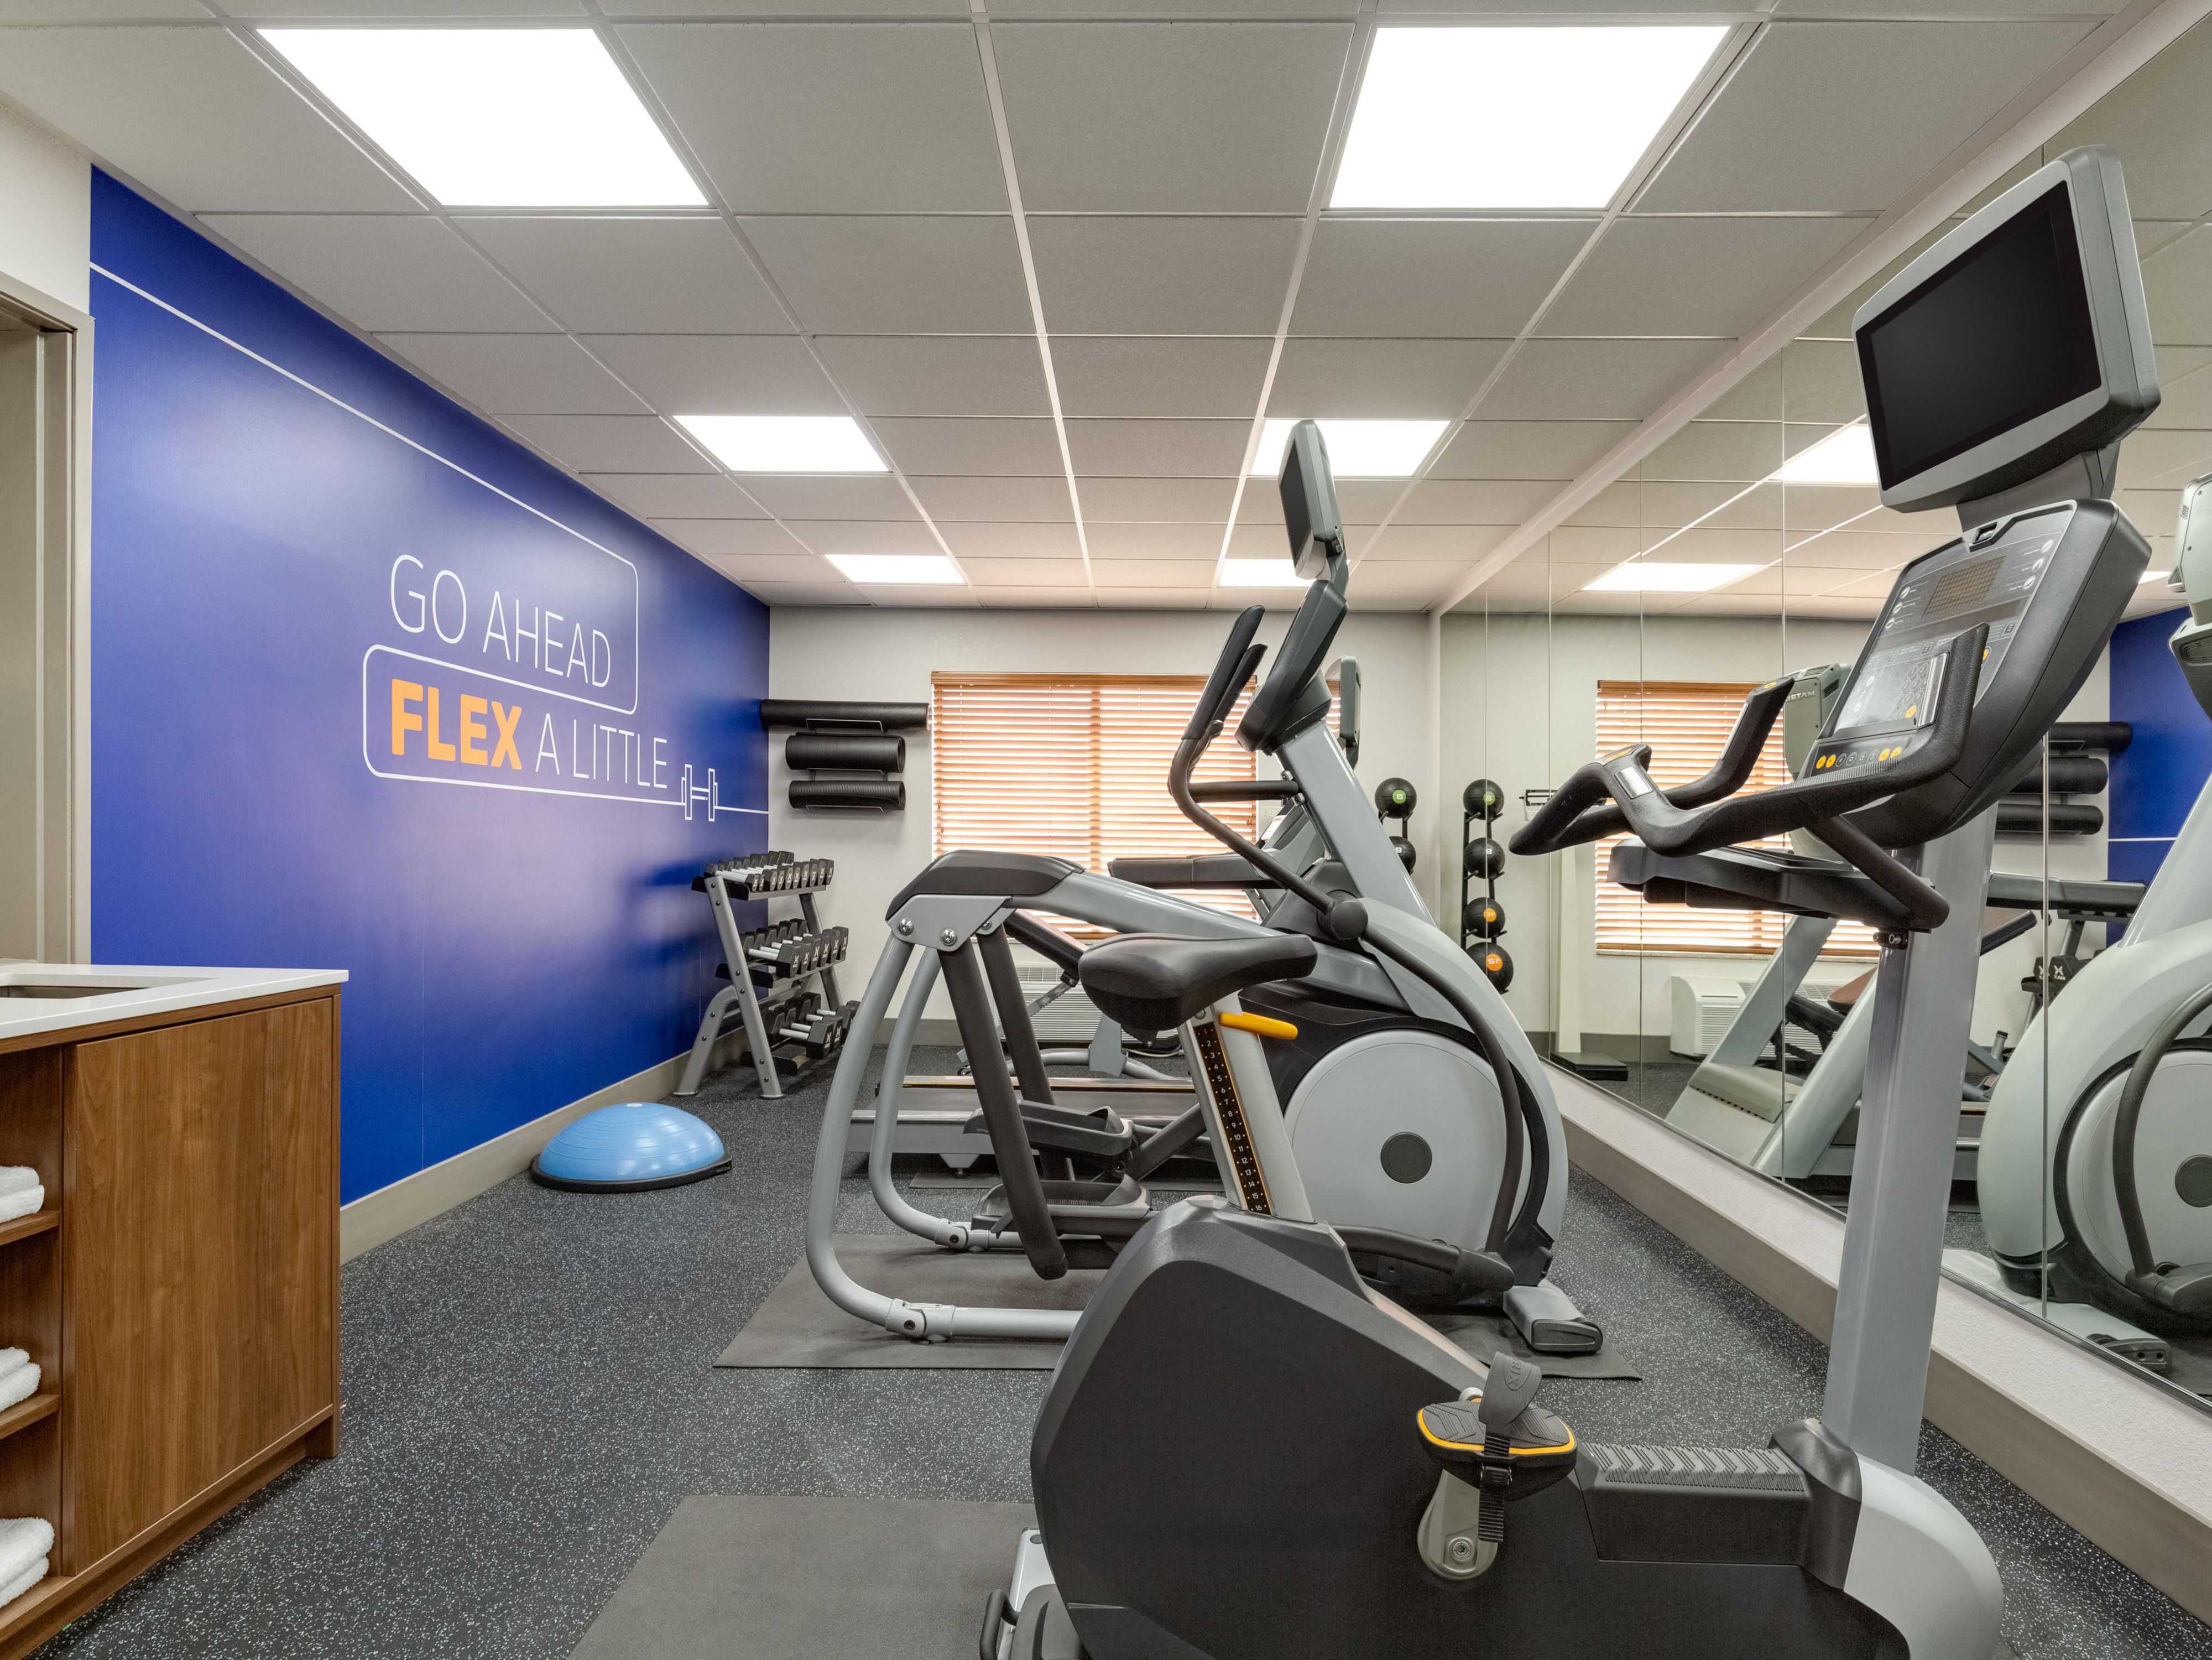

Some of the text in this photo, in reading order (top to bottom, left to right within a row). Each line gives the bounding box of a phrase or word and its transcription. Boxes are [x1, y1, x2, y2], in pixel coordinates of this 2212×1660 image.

[390, 554, 611, 688] GO AHEAD
[392, 679, 667, 789] FLEX A LITTLE
[1509, 1359, 1521, 1387] RIX
